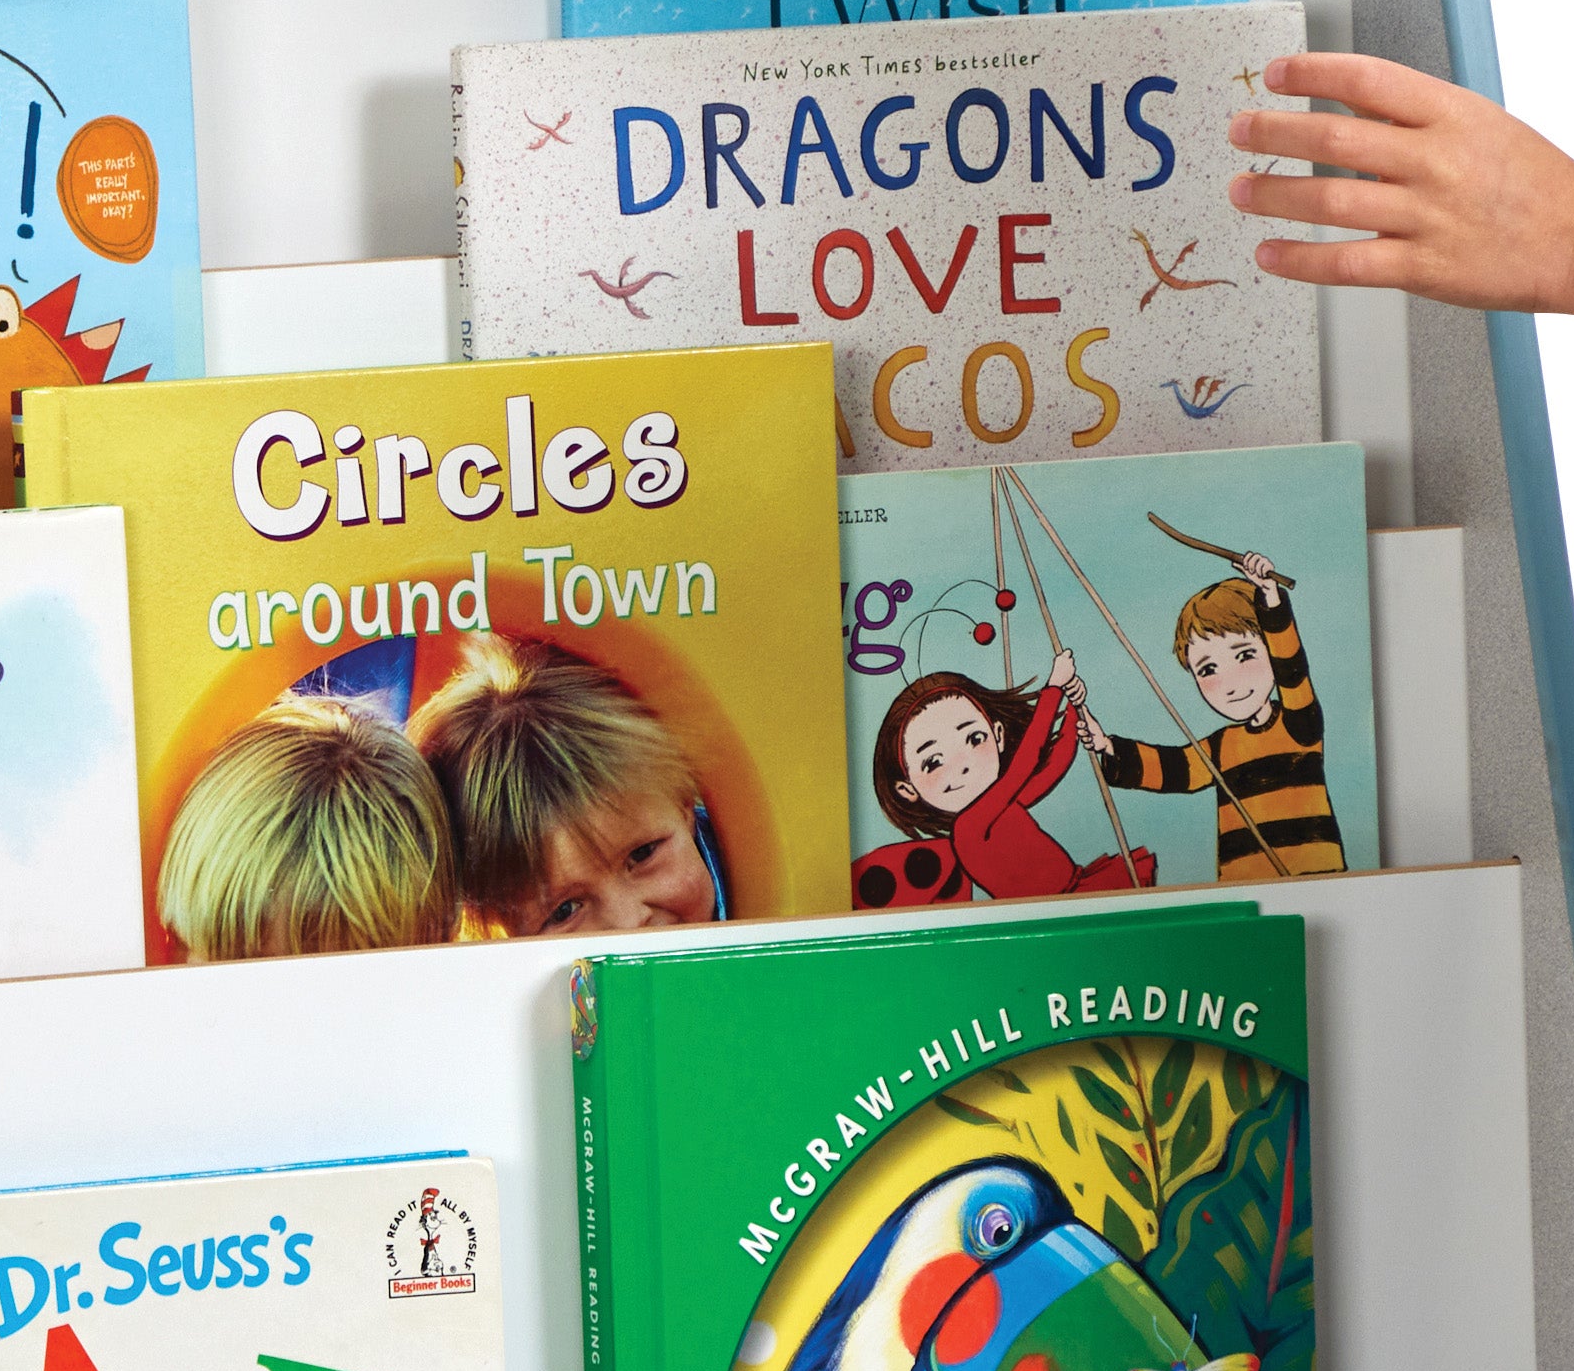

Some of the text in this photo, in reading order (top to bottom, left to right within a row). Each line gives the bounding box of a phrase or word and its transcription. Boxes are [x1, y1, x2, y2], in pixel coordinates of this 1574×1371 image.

[743, 52, 1041, 82] NEW YORK TIMES bestseller
[612, 75, 1180, 217] DRAGONS
[78, 159, 103, 175] THIS
[95, 174, 128, 189] REALLY
[102, 204, 134, 220] OKAY?
[736, 212, 1062, 327] LOVE
[231, 393, 689, 543] Circles
[209, 543, 717, 654] around Town
[737, 984, 1260, 1267] McGRAW-HILL READING
[407, 1200, 418, 1212] IT
[440, 1198, 458, 1213] ALL
[458, 1211, 472, 1224] BY
[387, 1210, 406, 1239] READ
[582, 1096, 601, 1365] McGRAW-HILL READING
[98, 1215, 315, 1307] Seuss's
[385, 1244, 398, 1268] CAN
[464, 1227, 477, 1271] MYSELF
[393, 1277, 472, 1294] Beginner Books
